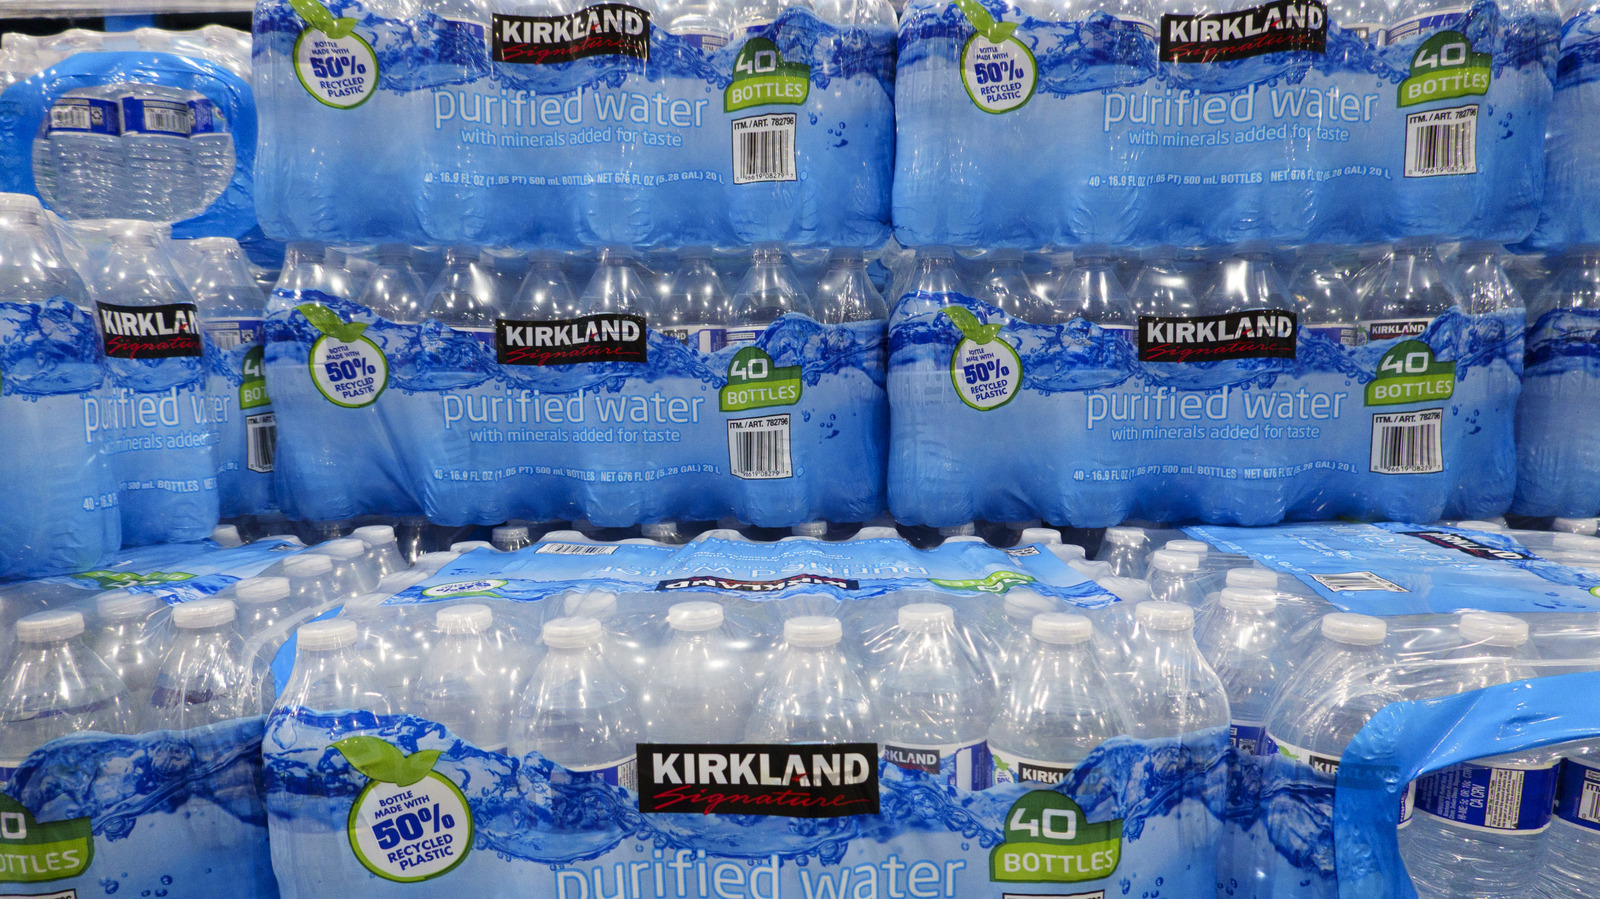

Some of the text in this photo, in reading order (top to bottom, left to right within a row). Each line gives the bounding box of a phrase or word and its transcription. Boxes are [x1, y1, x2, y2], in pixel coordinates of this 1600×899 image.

[502, 9, 644, 43] KIRKLAND
[1170, 4, 1323, 42] KIRKLAND
[502, 36, 643, 65] Signature
[1169, 34, 1322, 64] Signature
[1414, 43, 1467, 69] 40
[309, 55, 366, 78] 50%
[736, 50, 776, 74] 40
[974, 59, 1025, 84] 50%
[320, 77, 365, 89] RECYCLED
[327, 85, 365, 98] PLASTIC
[732, 83, 804, 104] BOTTLES
[981, 82, 1022, 95] RECYCLED
[1408, 74, 1489, 99] BOTTLES
[434, 87, 708, 128] purified water
[987, 91, 1021, 104] PLASTIC
[1103, 83, 1378, 131] purified water
[461, 126, 682, 148] with minerals added for taste
[1129, 122, 1350, 147] with minerals added for taste
[440, 172, 460, 183] 16.9
[597, 173, 613, 184] NET
[1090, 176, 1100, 187] 40
[1108, 175, 1127, 187] 16.9
[1221, 174, 1262, 184] BOTTLES
[1270, 170, 1289, 182] NET
[101, 310, 200, 337] KIRKLAN
[506, 319, 641, 347] KIRKLAND
[1147, 315, 1293, 343] KIRKLAND
[1372, 323, 1425, 335] KIRKLAND
[326, 353, 343, 361] MADE
[328, 345, 350, 354] BOTTLE
[506, 346, 641, 367] Signature
[1147, 341, 1292, 364] Signature
[325, 357, 377, 382] 50%
[731, 358, 768, 380] 40
[964, 358, 1010, 385] 50%
[1381, 352, 1429, 373] 40
[335, 377, 374, 392] RECYCLED
[342, 385, 376, 399] PLASTIC
[727, 385, 797, 405] BOTTLES
[971, 379, 1008, 394] RECYCLED
[976, 387, 1008, 402] PLASTIC
[1374, 380, 1453, 400] BOTTLES
[443, 388, 704, 429] purified water
[1086, 385, 1347, 430] purified water
[767, 417, 789, 427] 782796
[1111, 424, 1320, 441] with minerals added for taste
[469, 428, 681, 443] with minerals added for taste
[450, 470, 468, 481] 16.9
[567, 469, 595, 481] BOTTLES
[601, 471, 616, 482] NET
[618, 471, 632, 482] 676
[1073, 470, 1084, 480] 40
[1092, 470, 1109, 481] 16.9
[1162, 465, 1178, 474] 500
[1197, 466, 1236, 479] BOTTLES
[1244, 468, 1261, 479] NET
[653, 753, 871, 787] KIRKLAND
[374, 795, 431, 820] MADE WITH
[379, 790, 414, 807] BOTTLE
[653, 785, 871, 816] Signature
[372, 803, 456, 851] 50%
[1010, 808, 1077, 840] 40
[387, 834, 454, 863] RECYCLED
[399, 846, 454, 871] PLASTIC
[1004, 850, 1114, 874] BOTTLES
[804, 854, 967, 899] water
